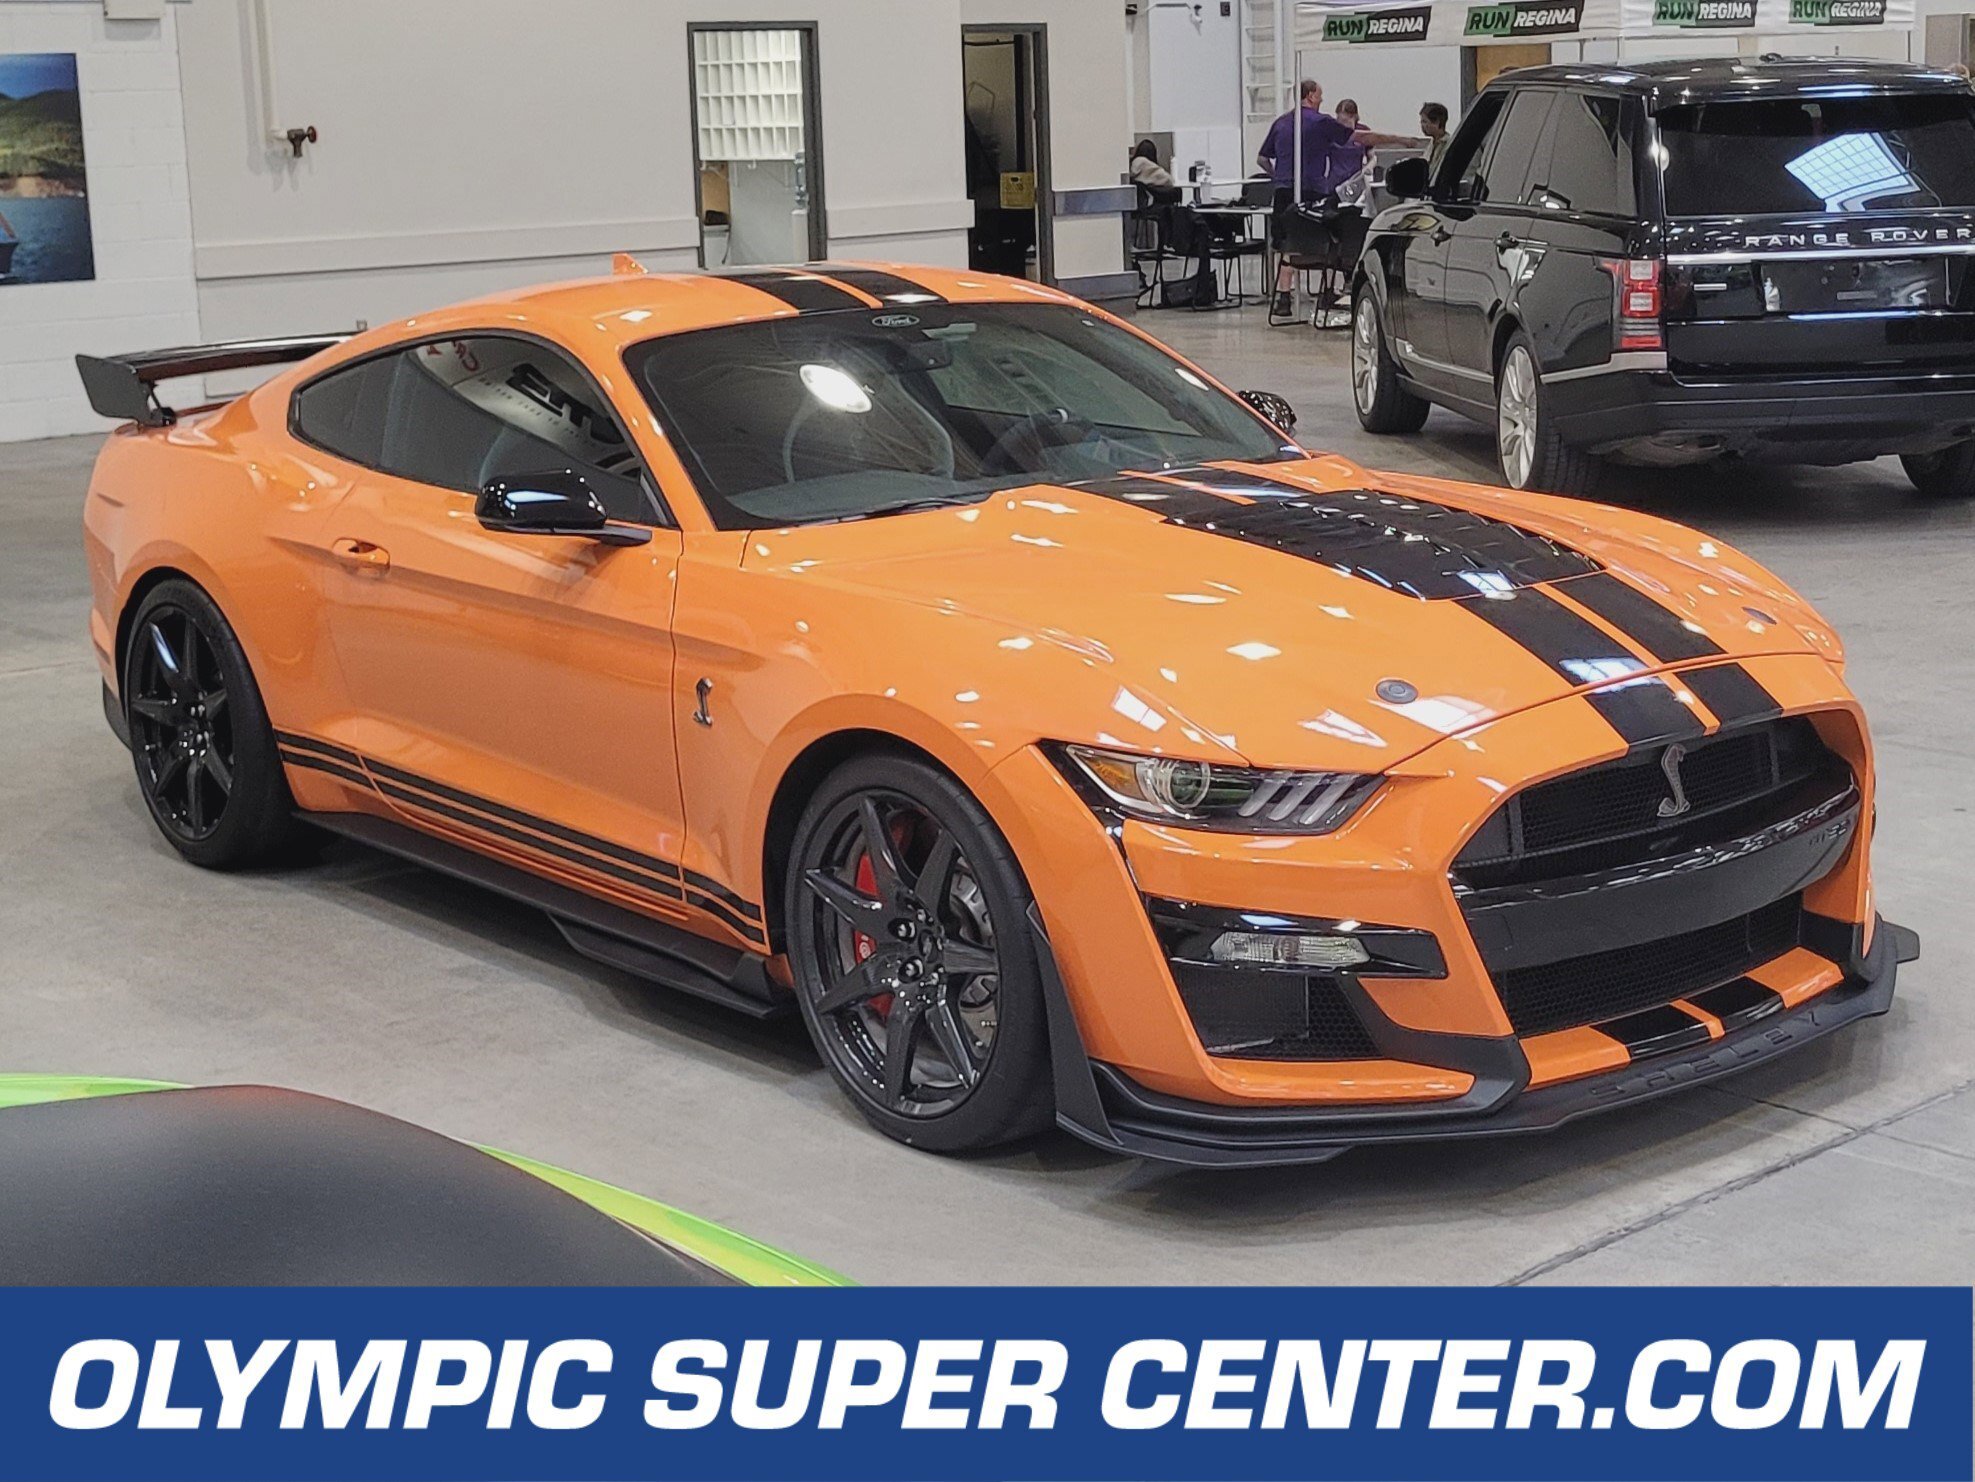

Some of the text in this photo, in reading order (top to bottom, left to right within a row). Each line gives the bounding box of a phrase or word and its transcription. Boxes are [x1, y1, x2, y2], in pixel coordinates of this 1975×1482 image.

[1468, 7, 1577, 29] RUN REGINA
[1655, 0, 1752, 20] RUN REGINA
[1792, 0, 1882, 17] RUN REGINA
[1326, 15, 1425, 36] RUN REGINA
[1743, 228, 1972, 248] RANGE ROVER
